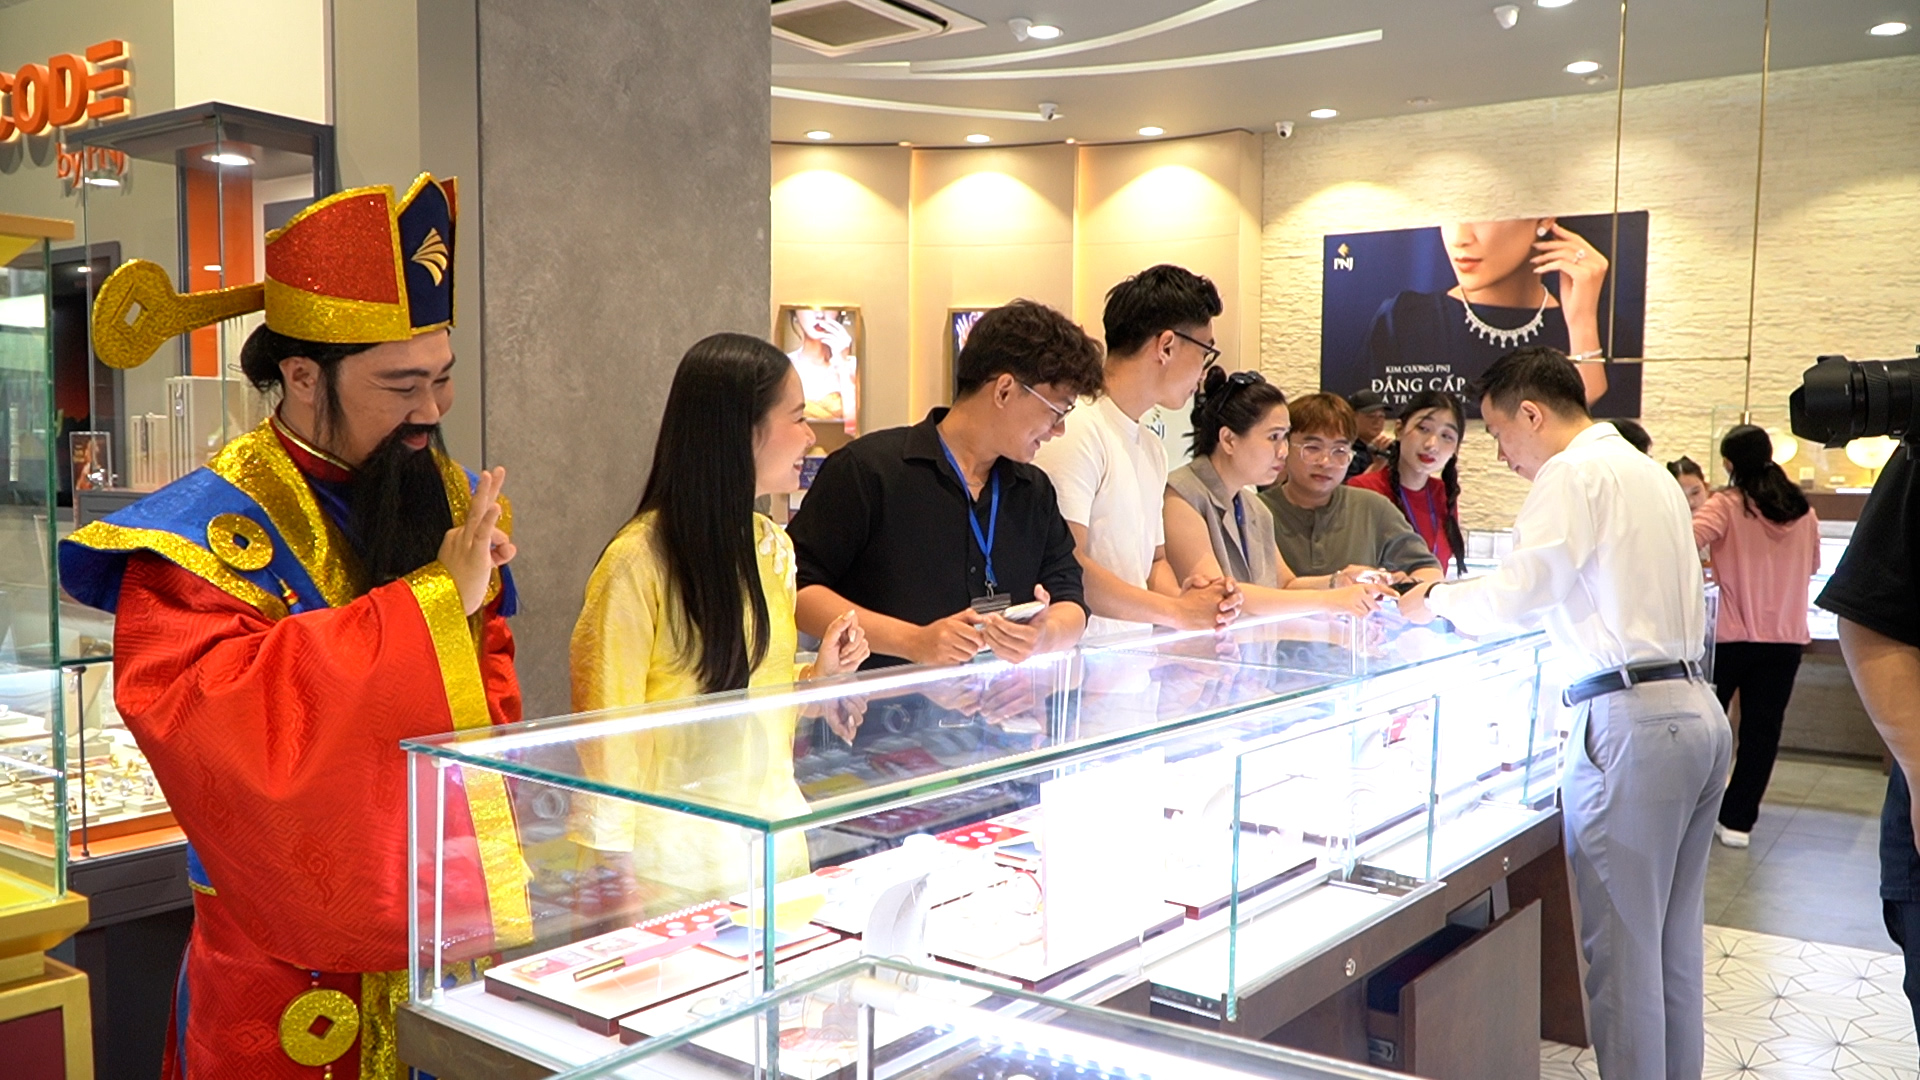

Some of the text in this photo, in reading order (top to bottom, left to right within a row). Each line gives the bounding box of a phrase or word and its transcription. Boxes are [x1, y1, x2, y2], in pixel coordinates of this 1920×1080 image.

[56, 142, 84, 188] by
[1333, 257, 1354, 271] PNJ
[1385, 365, 1401, 374] KIM
[1435, 364, 1451, 374] PNJ
